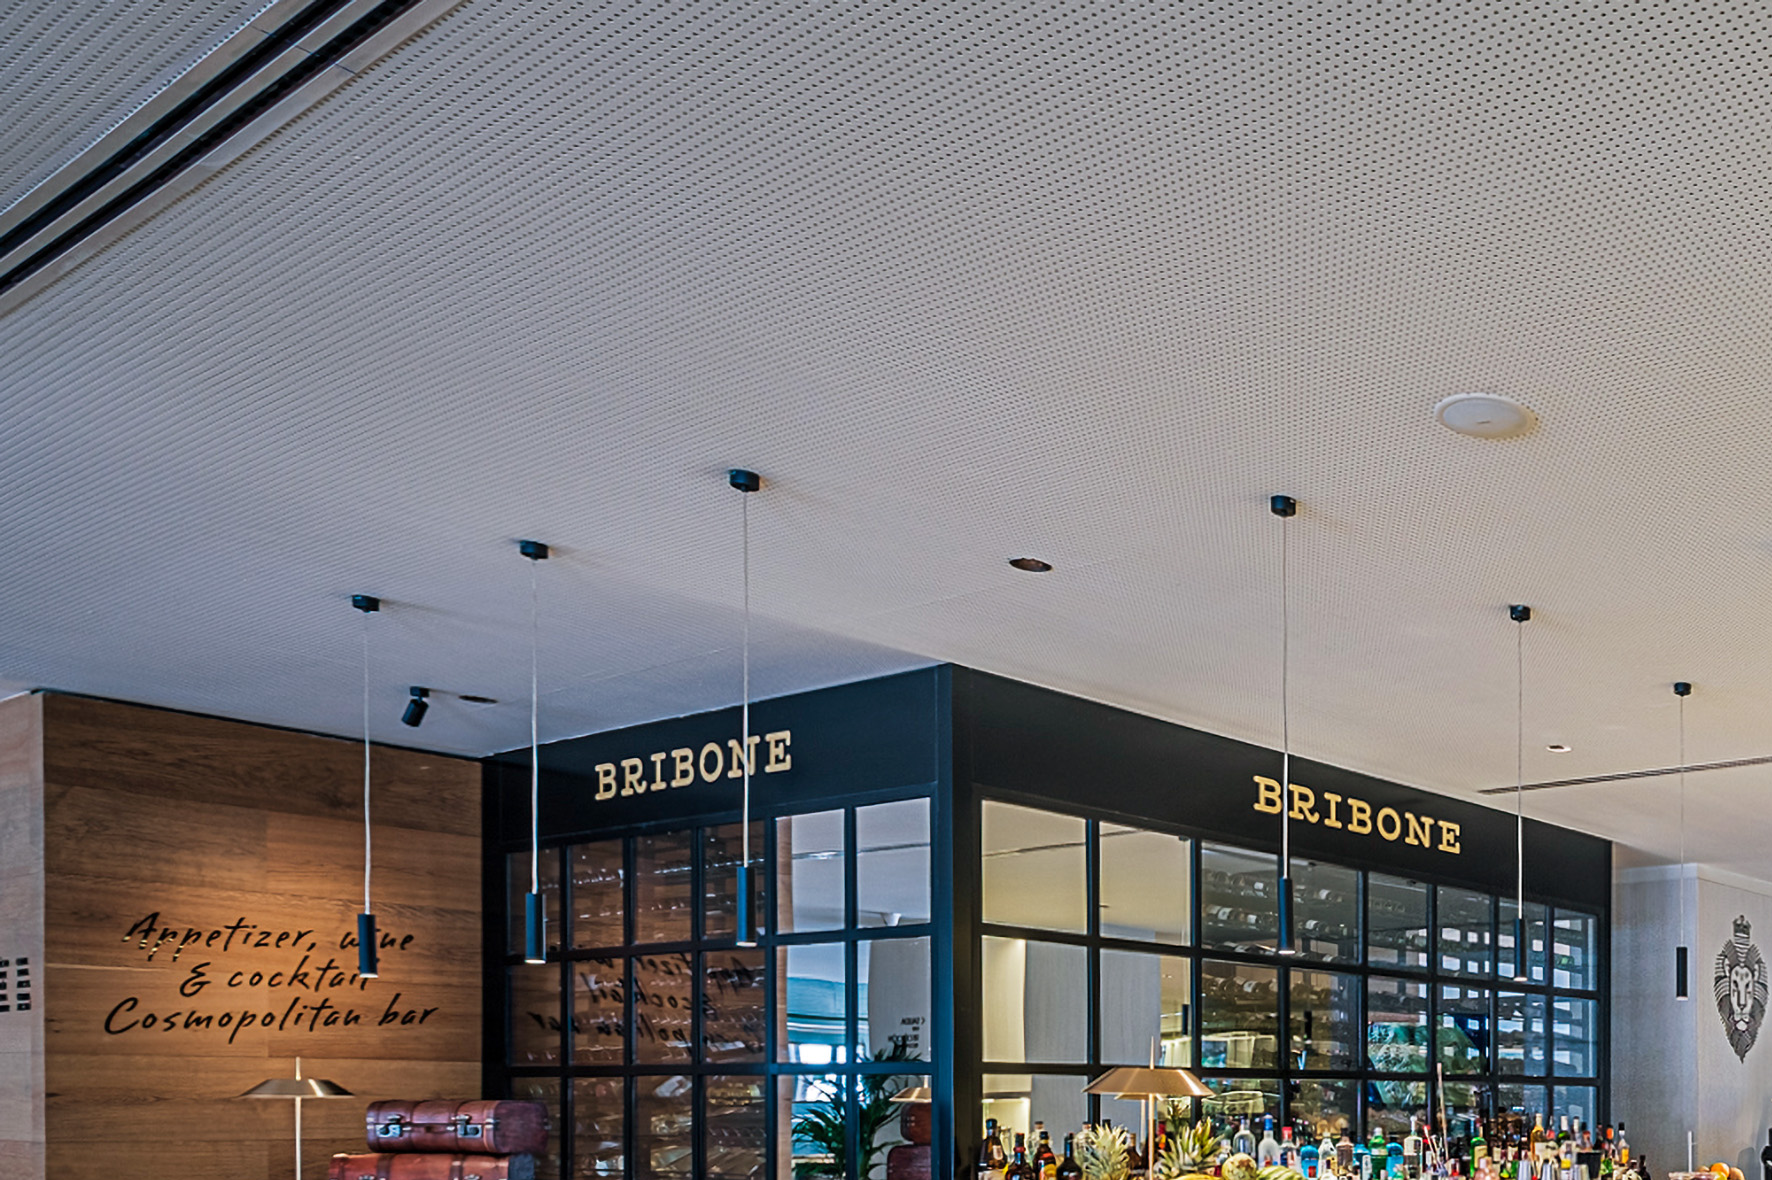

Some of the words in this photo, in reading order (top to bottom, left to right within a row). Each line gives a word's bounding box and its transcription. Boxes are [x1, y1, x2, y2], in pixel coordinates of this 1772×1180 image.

[594, 730, 793, 801] BRIBONE
[1252, 775, 1461, 855] BRIBONE
[121, 912, 317, 962] Appetizer,
[340, 928, 414, 950] wne
[179, 962, 212, 997] &
[104, 997, 361, 1044] Cosmopolitan
[378, 993, 439, 1026] bar
